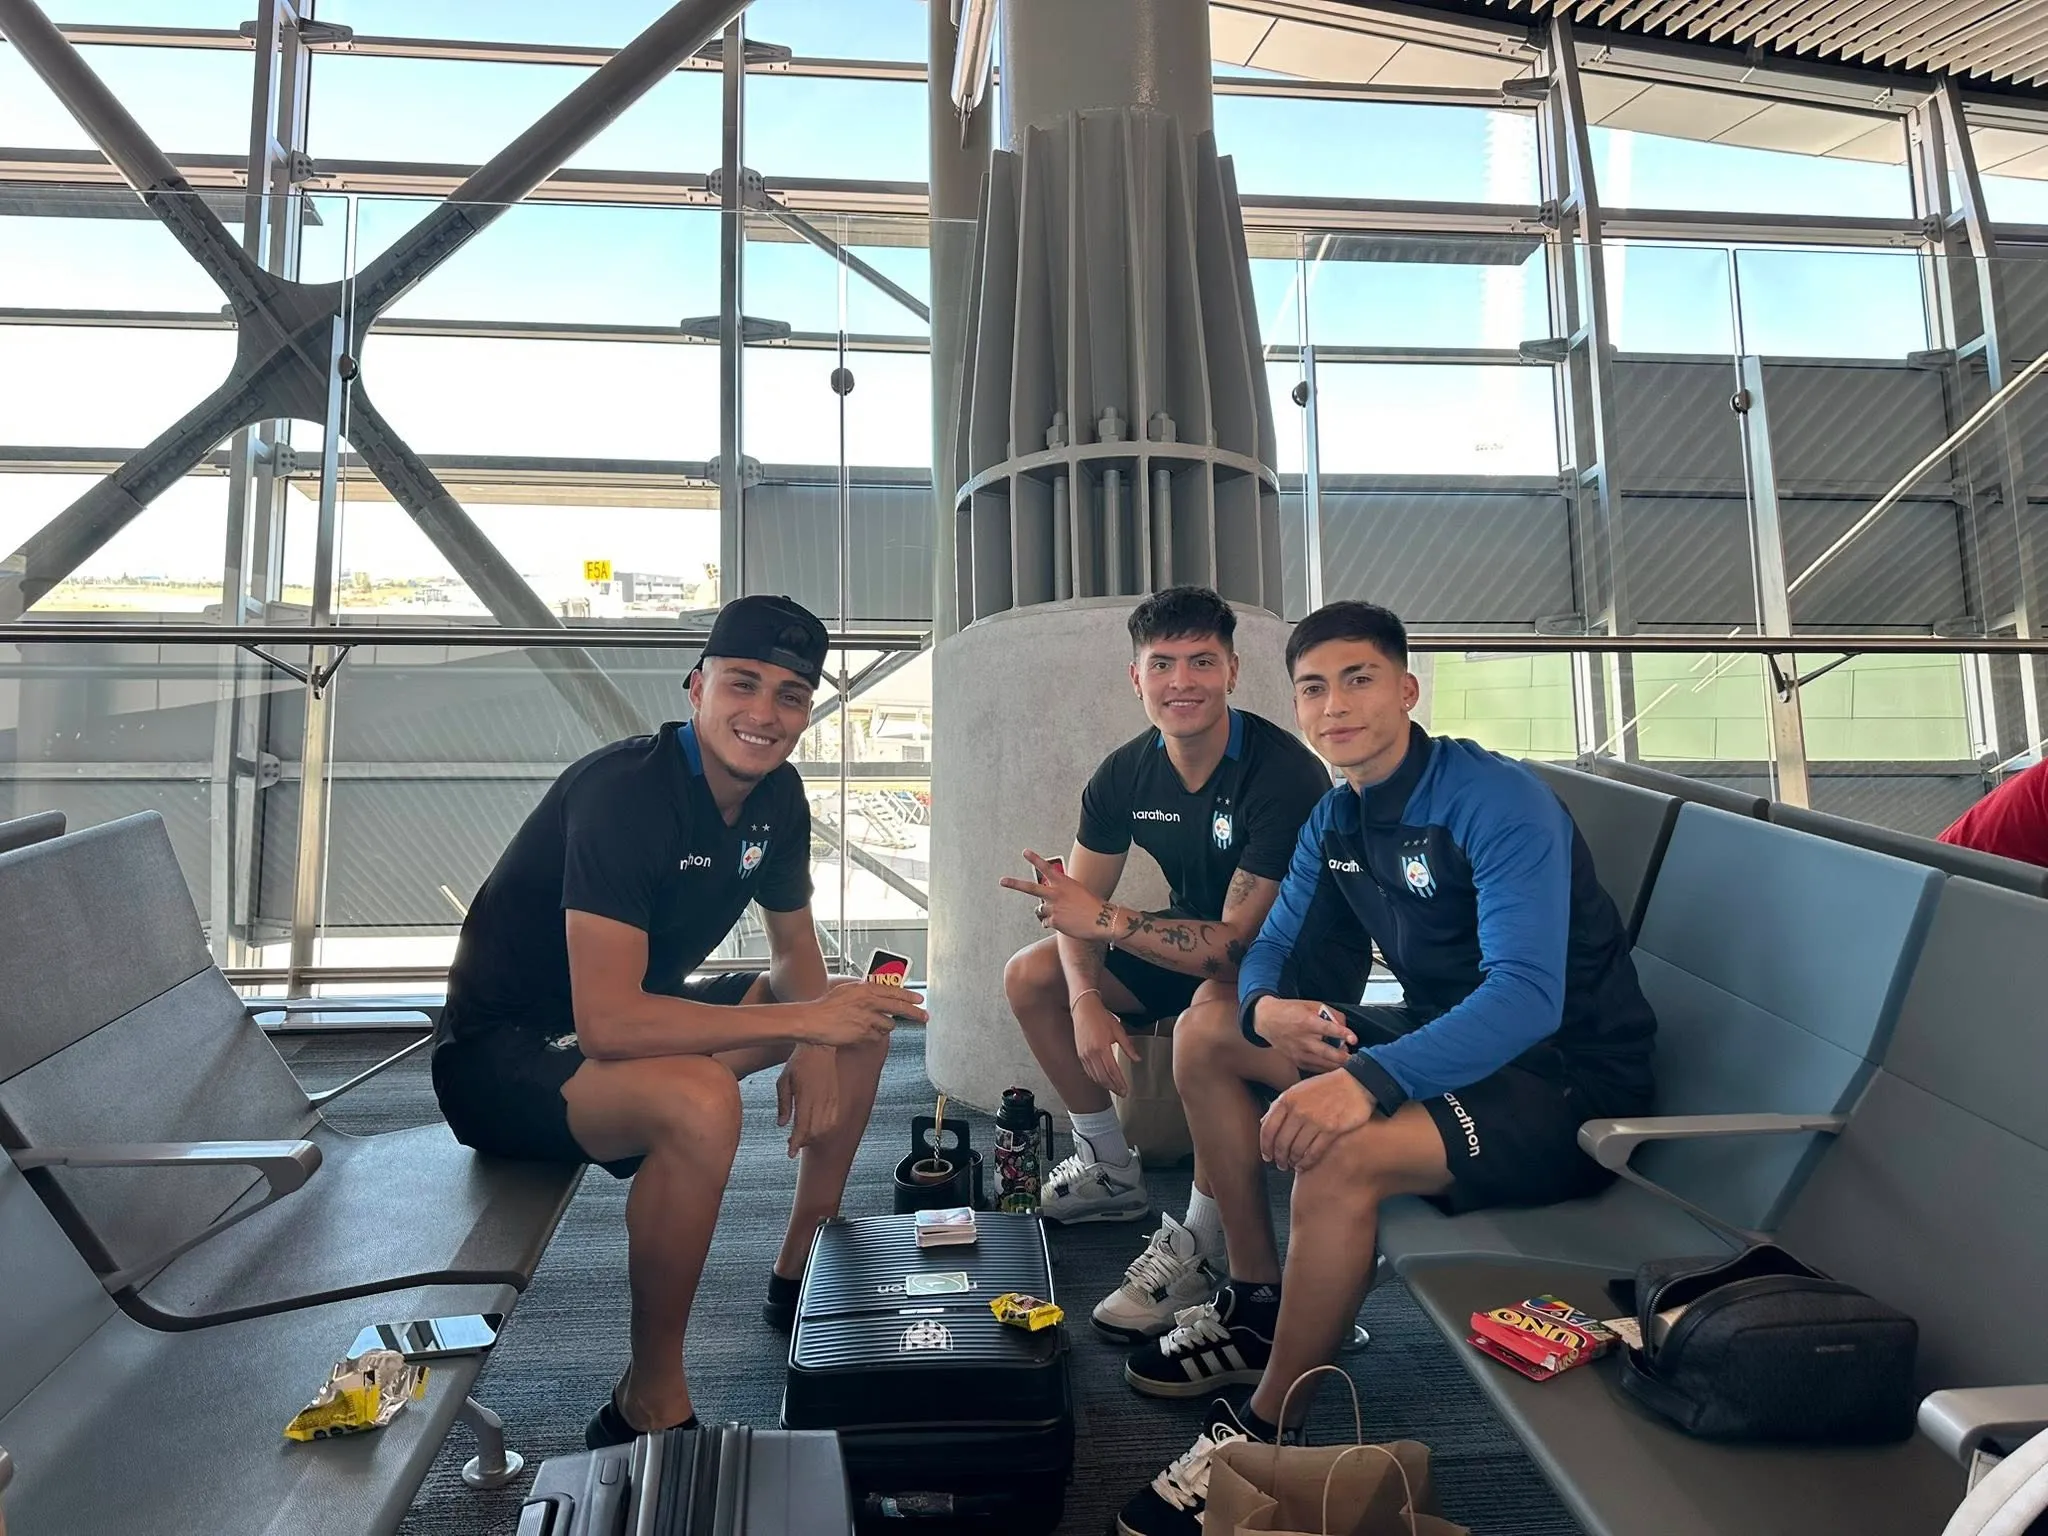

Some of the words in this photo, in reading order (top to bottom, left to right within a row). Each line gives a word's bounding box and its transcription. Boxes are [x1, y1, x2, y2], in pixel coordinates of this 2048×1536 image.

[586, 561, 608, 579] F5A
[1132, 809, 1180, 822] arathon
[1443, 1092, 1480, 1157] arathon
[1488, 1308, 1583, 1348] UNO
